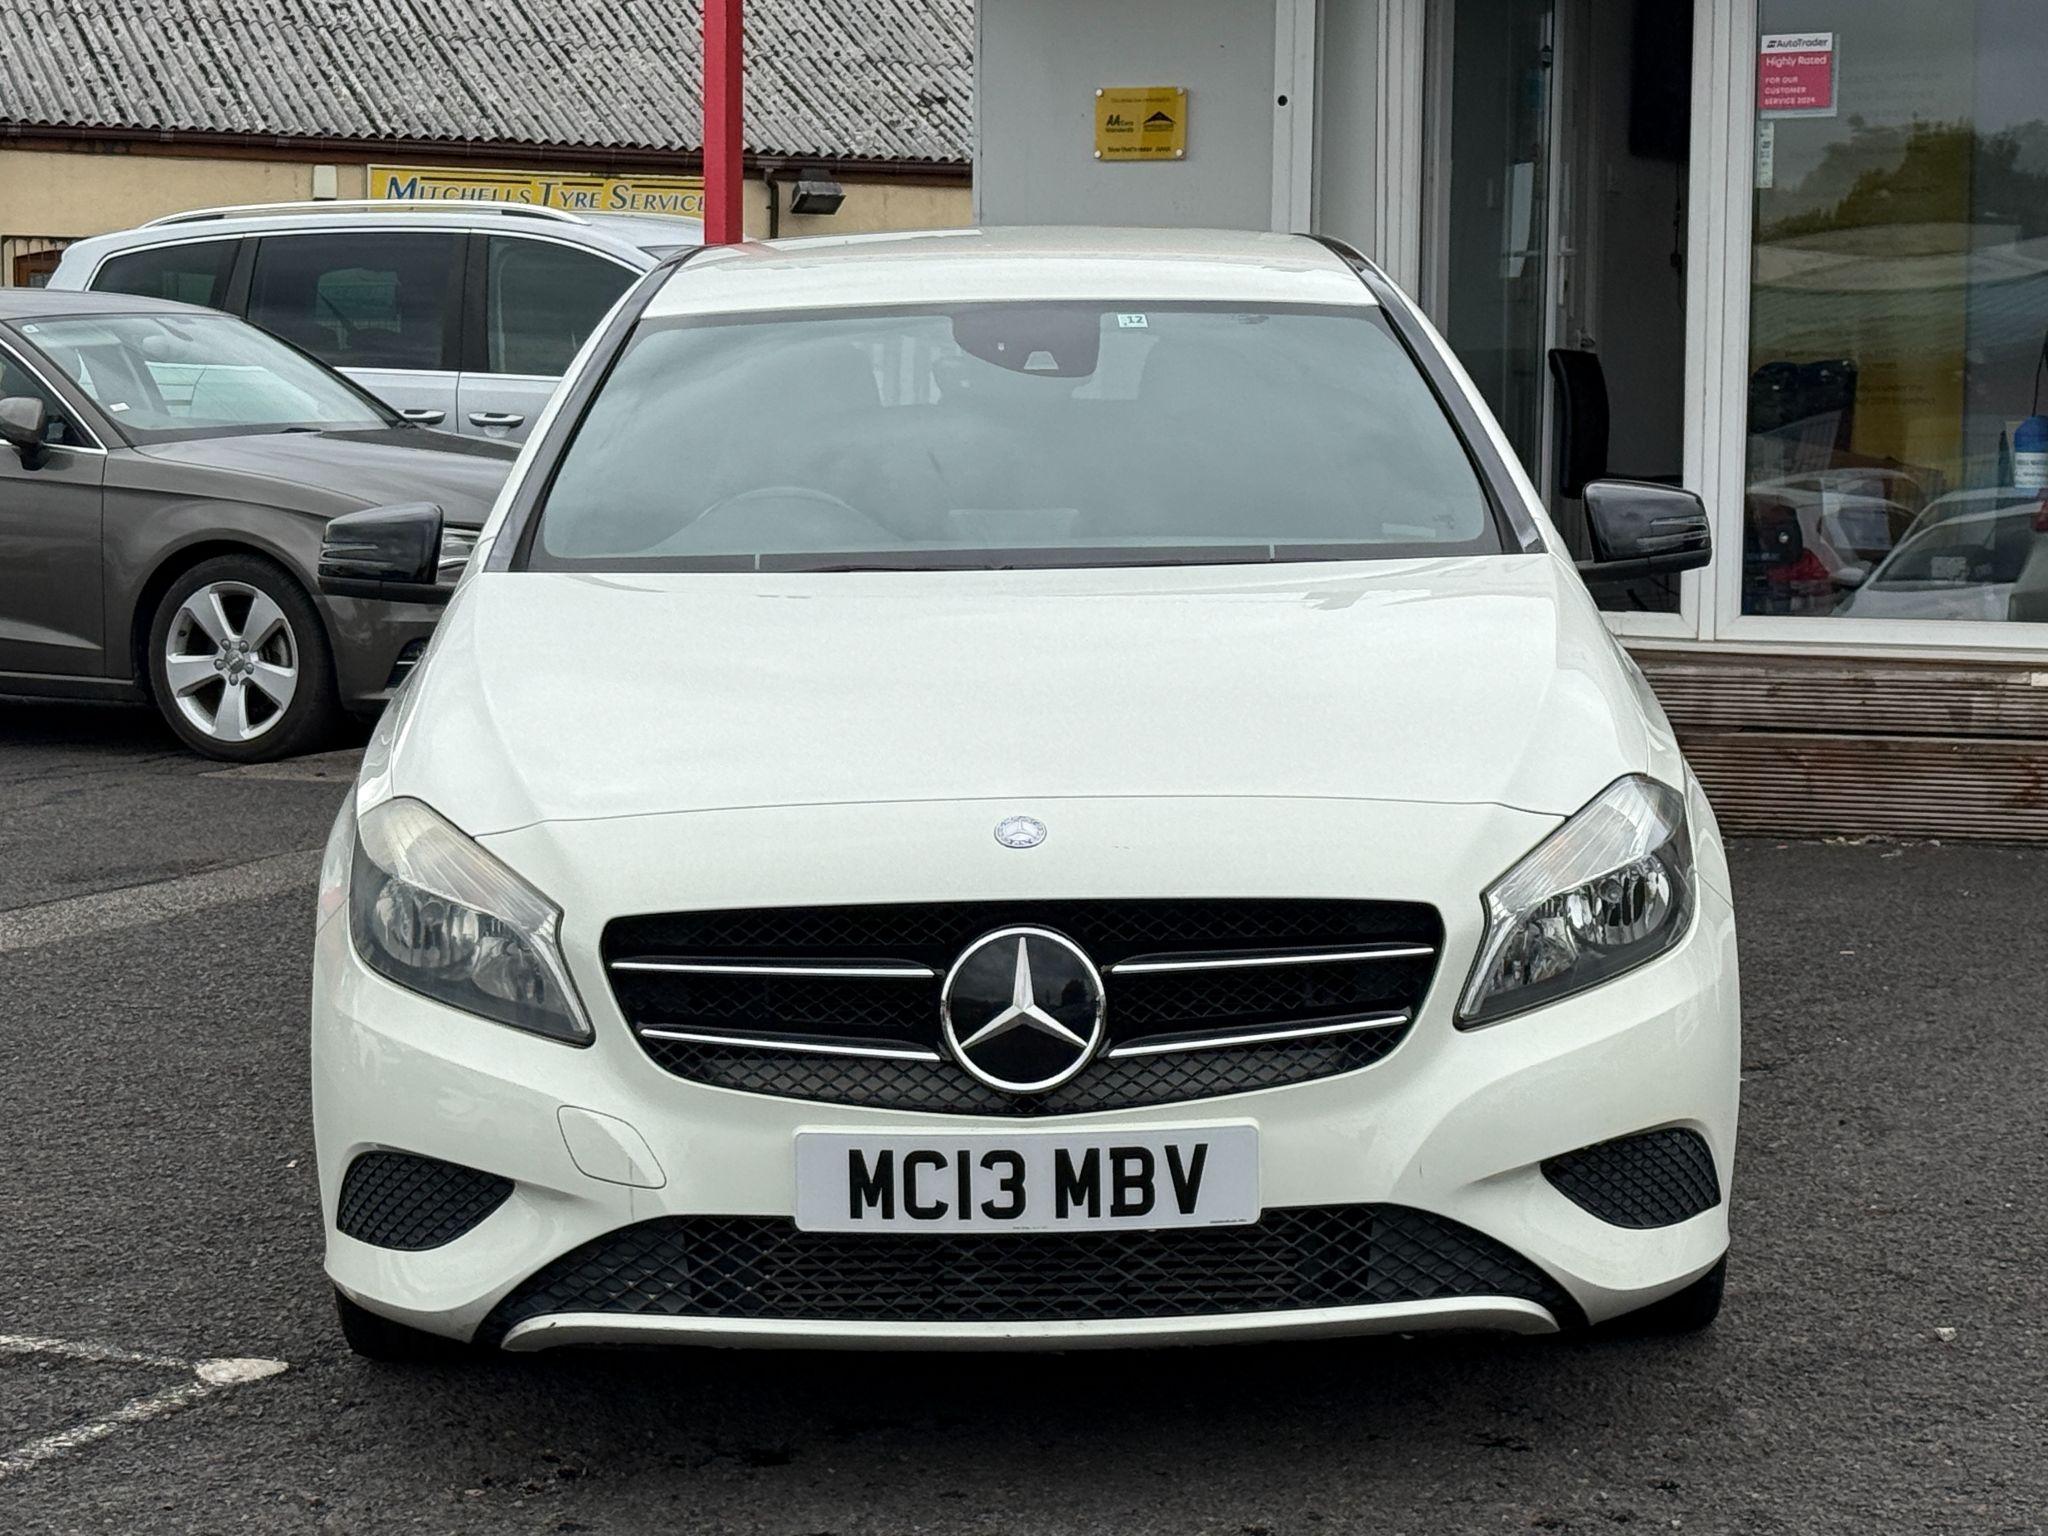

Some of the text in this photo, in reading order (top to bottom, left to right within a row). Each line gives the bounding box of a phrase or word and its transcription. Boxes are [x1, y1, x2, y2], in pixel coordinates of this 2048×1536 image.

[1776, 38, 1828, 48] AutoTrader
[1766, 54, 1827, 68] Highly Rated
[1764, 86, 1806, 95] CUSTOMER
[538, 182, 601, 208] TYRE
[1127, 315, 1144, 324] 12
[848, 1143, 1209, 1220] MC13 MBV
